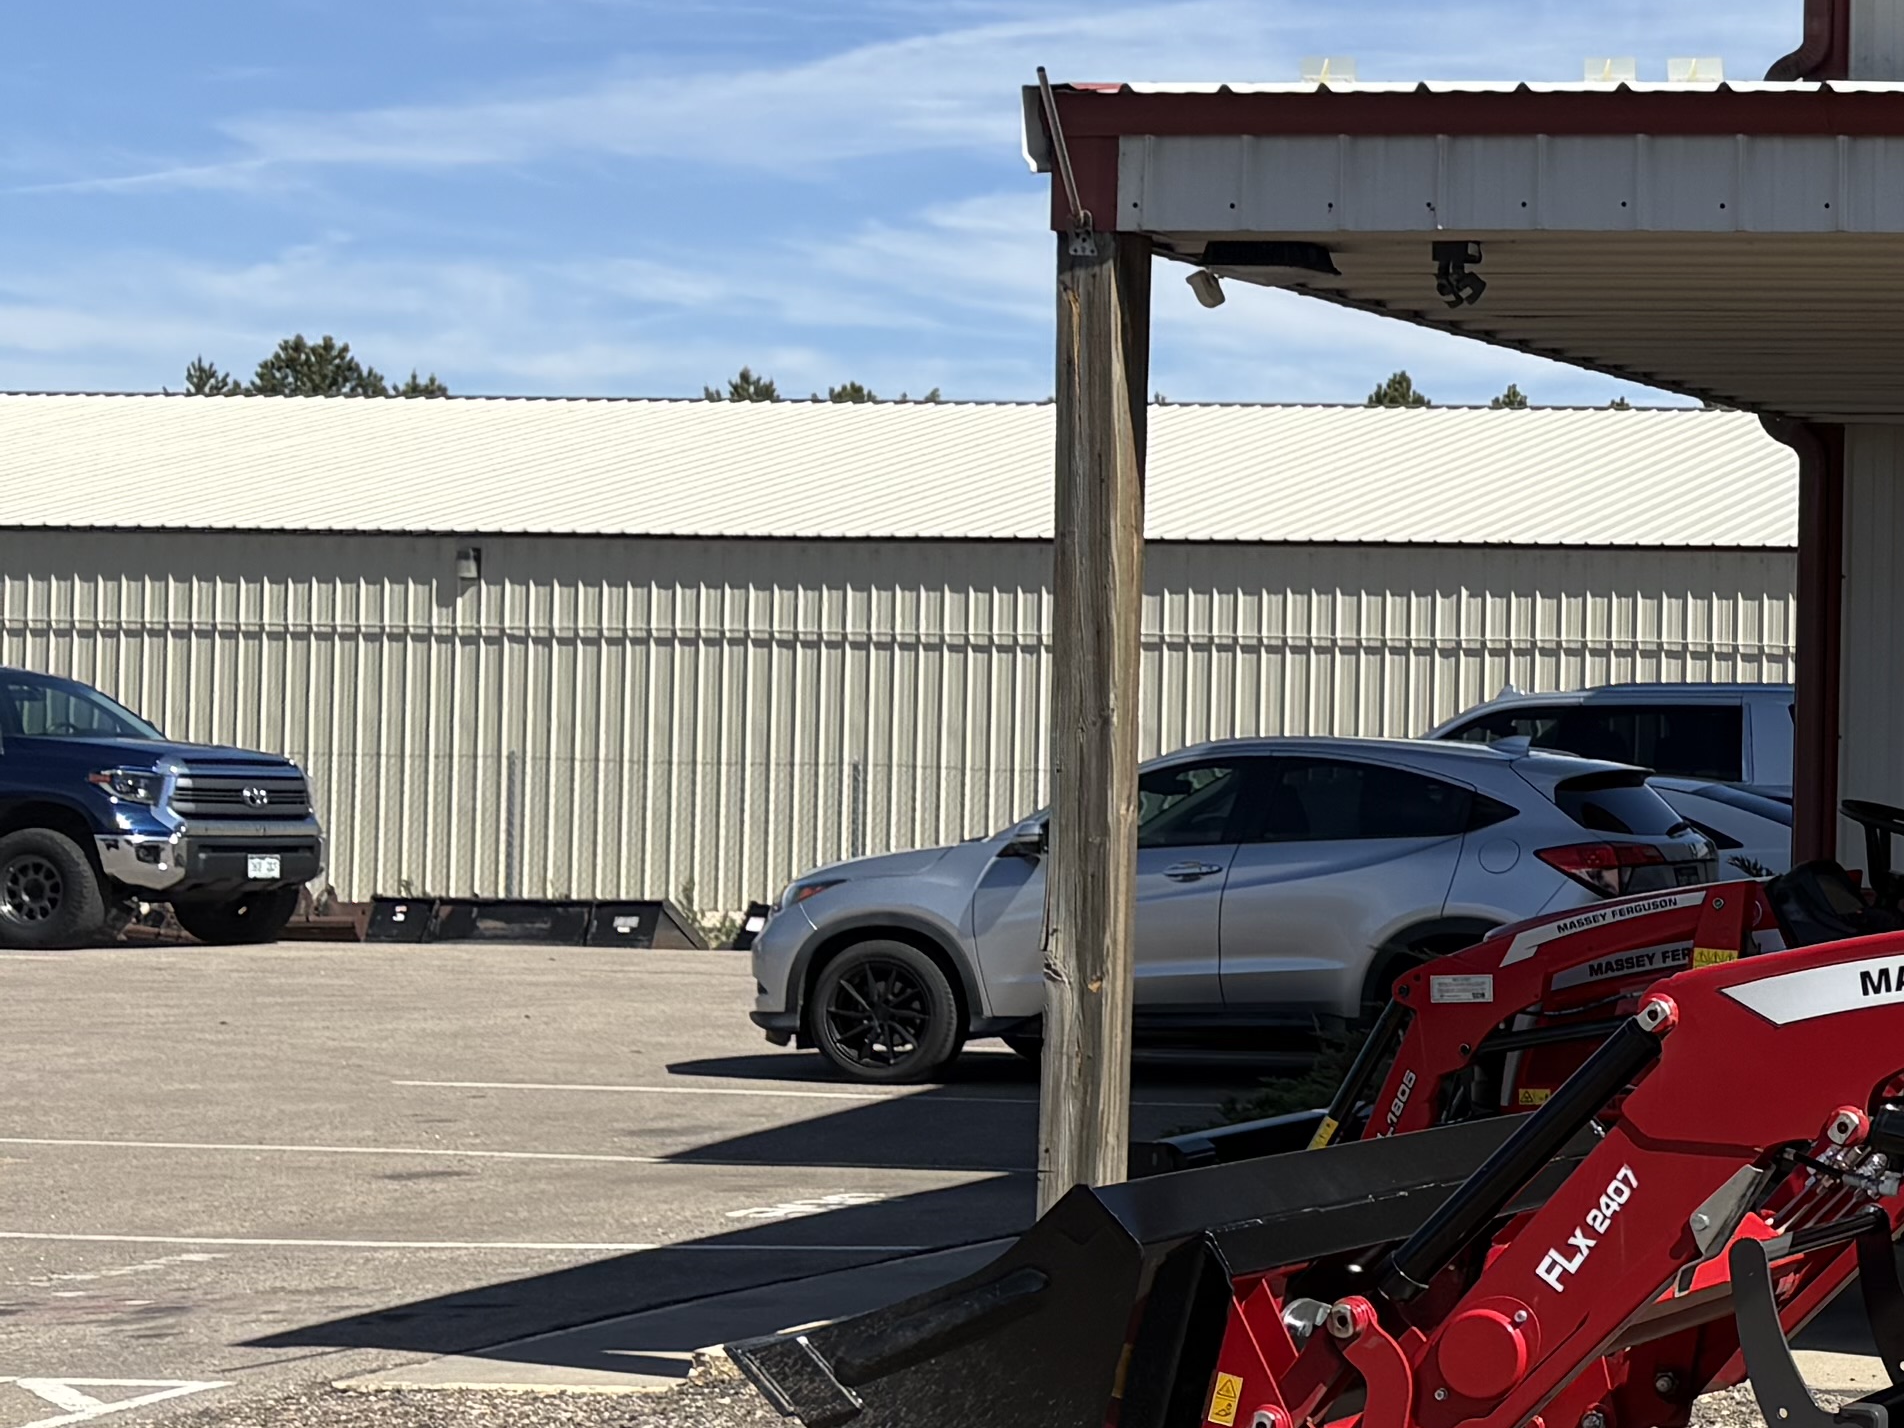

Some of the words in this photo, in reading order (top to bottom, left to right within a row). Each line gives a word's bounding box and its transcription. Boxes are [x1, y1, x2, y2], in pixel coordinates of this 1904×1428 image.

[1556, 912, 1607, 934] MASSEY
[1611, 897, 1678, 919] FERGUSON
[1588, 951, 1655, 977] MASSEY
[1585, 1163, 1639, 1234] 2407
